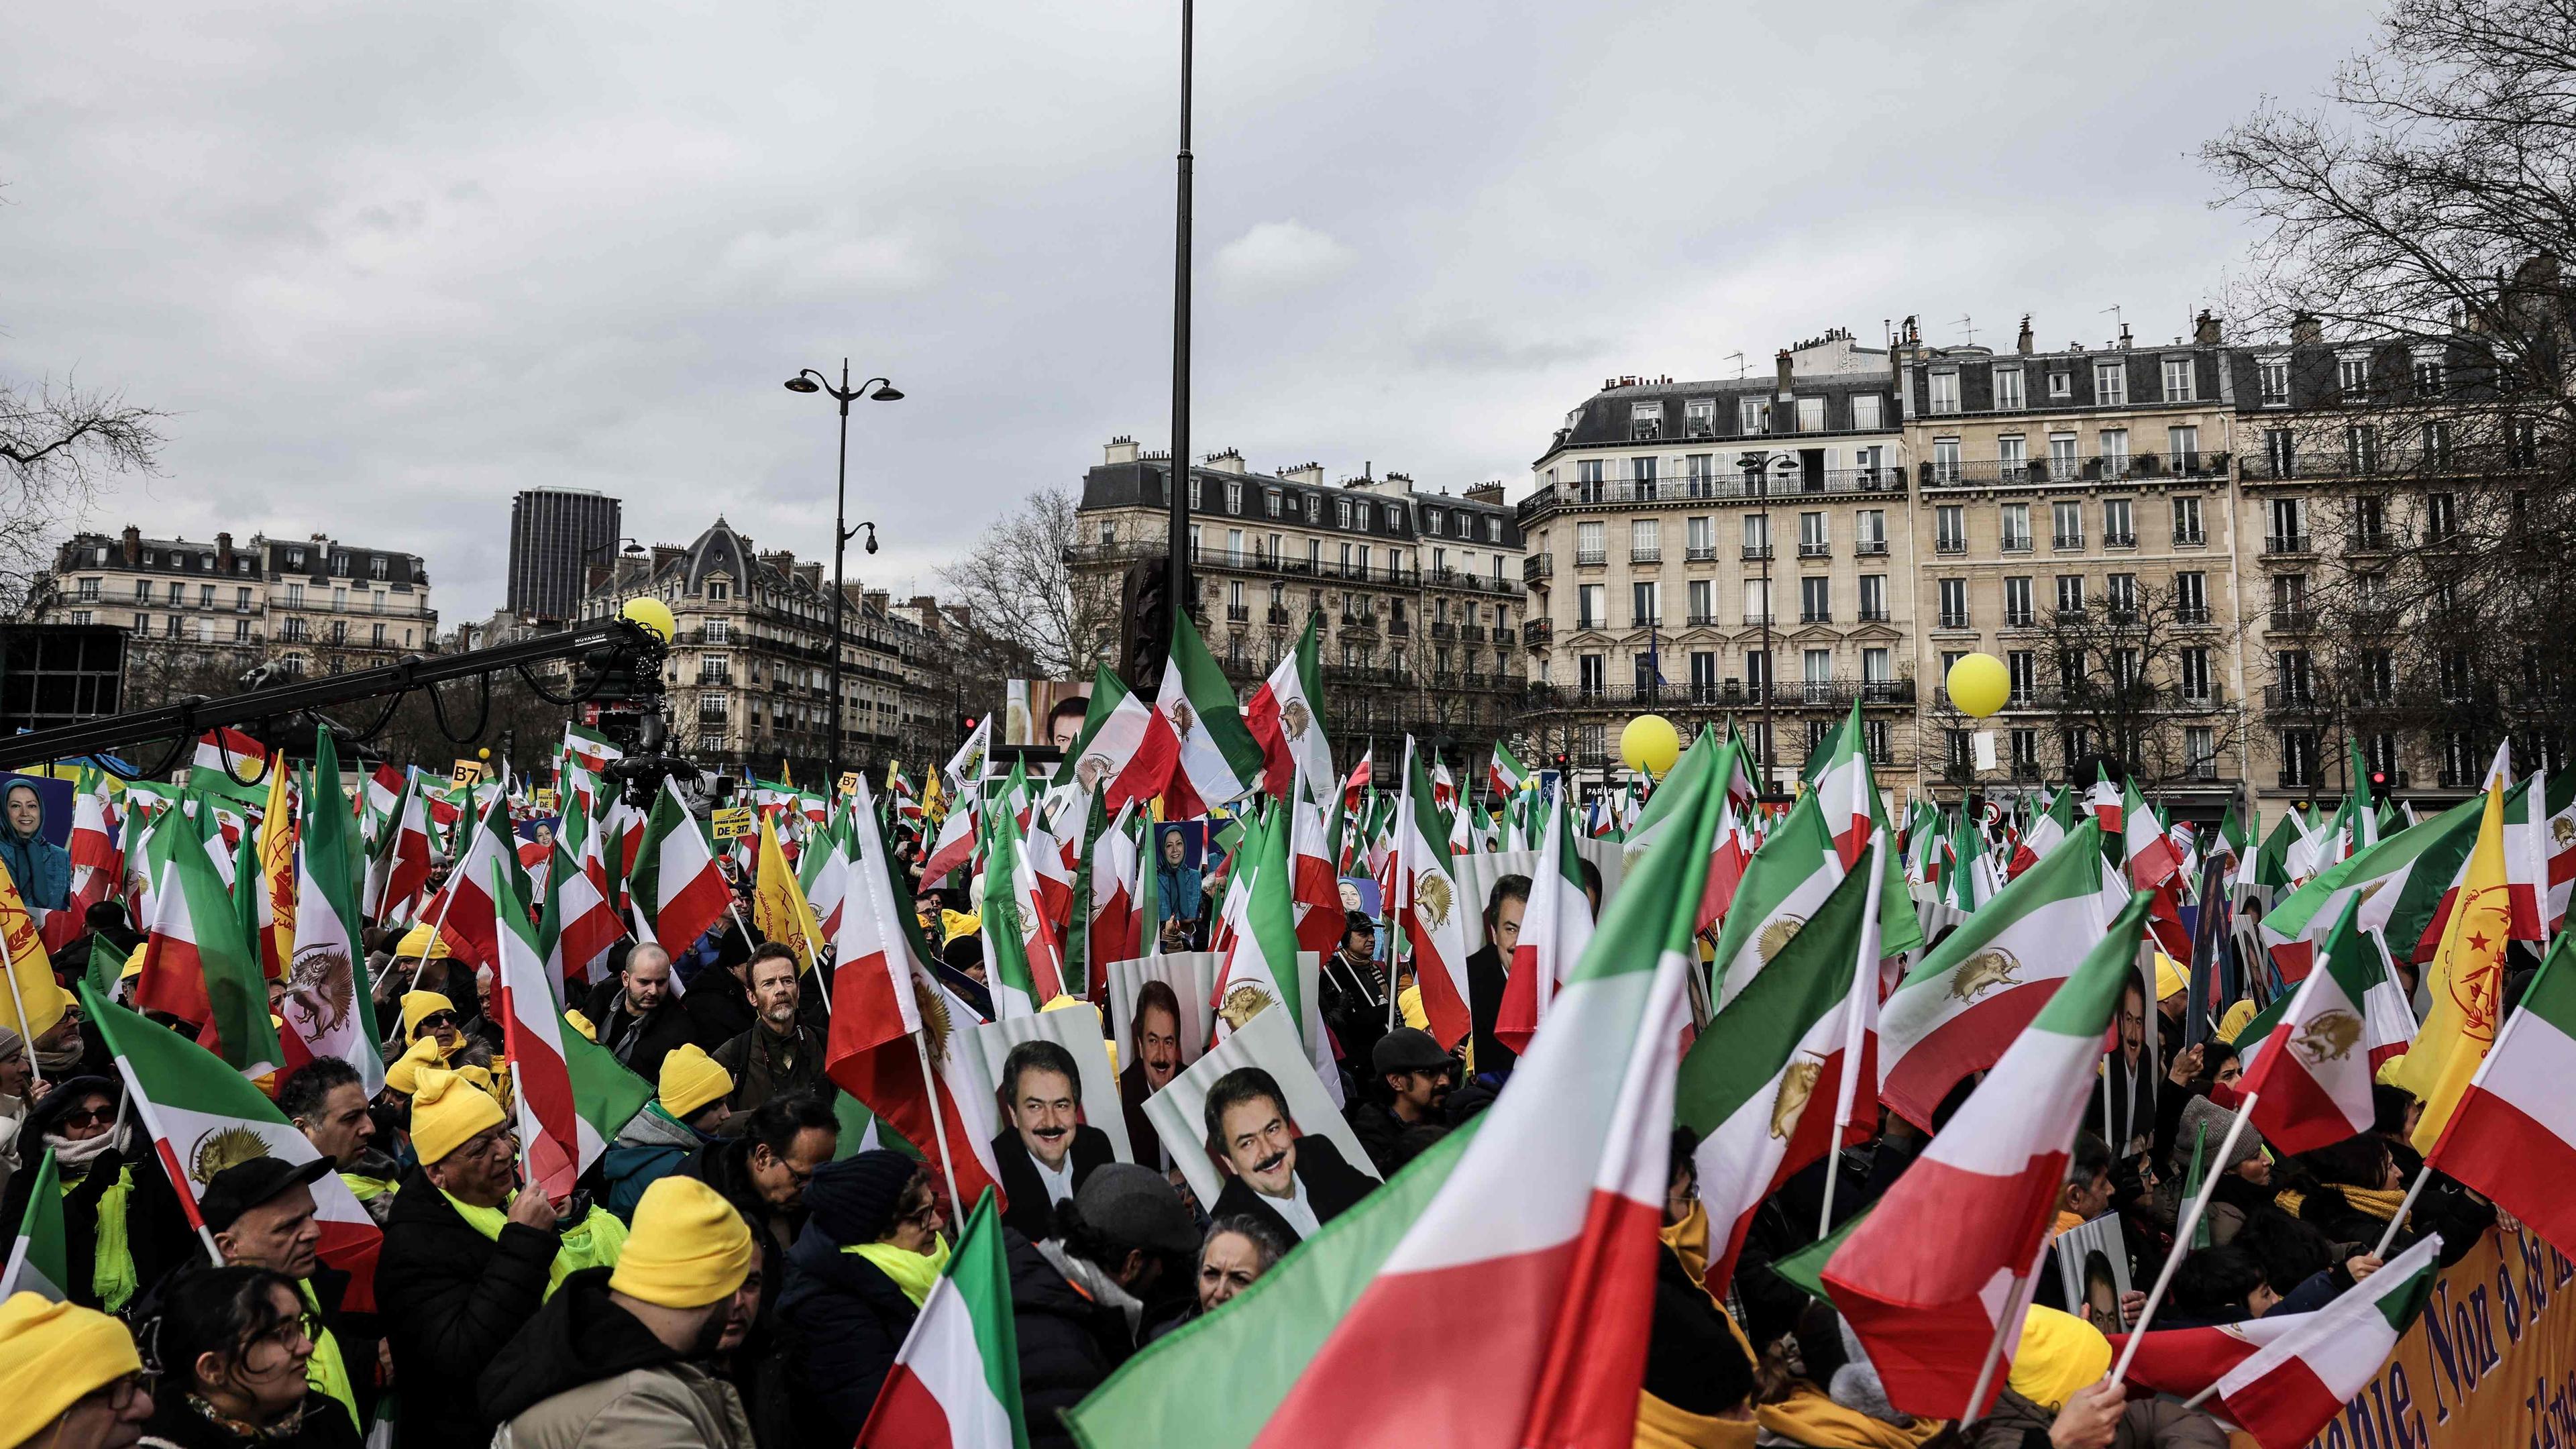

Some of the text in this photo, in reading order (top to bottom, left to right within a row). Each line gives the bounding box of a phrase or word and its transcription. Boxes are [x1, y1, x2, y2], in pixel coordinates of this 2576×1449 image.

[453, 766, 479, 786] B7
[843, 776, 857, 789] B7
[717, 826, 731, 837] DE
[736, 824, 749, 834] 317
[2424, 1279, 2501, 1427] Non
[2494, 1231, 2522, 1349] à
[2518, 1221, 2549, 1326] la
